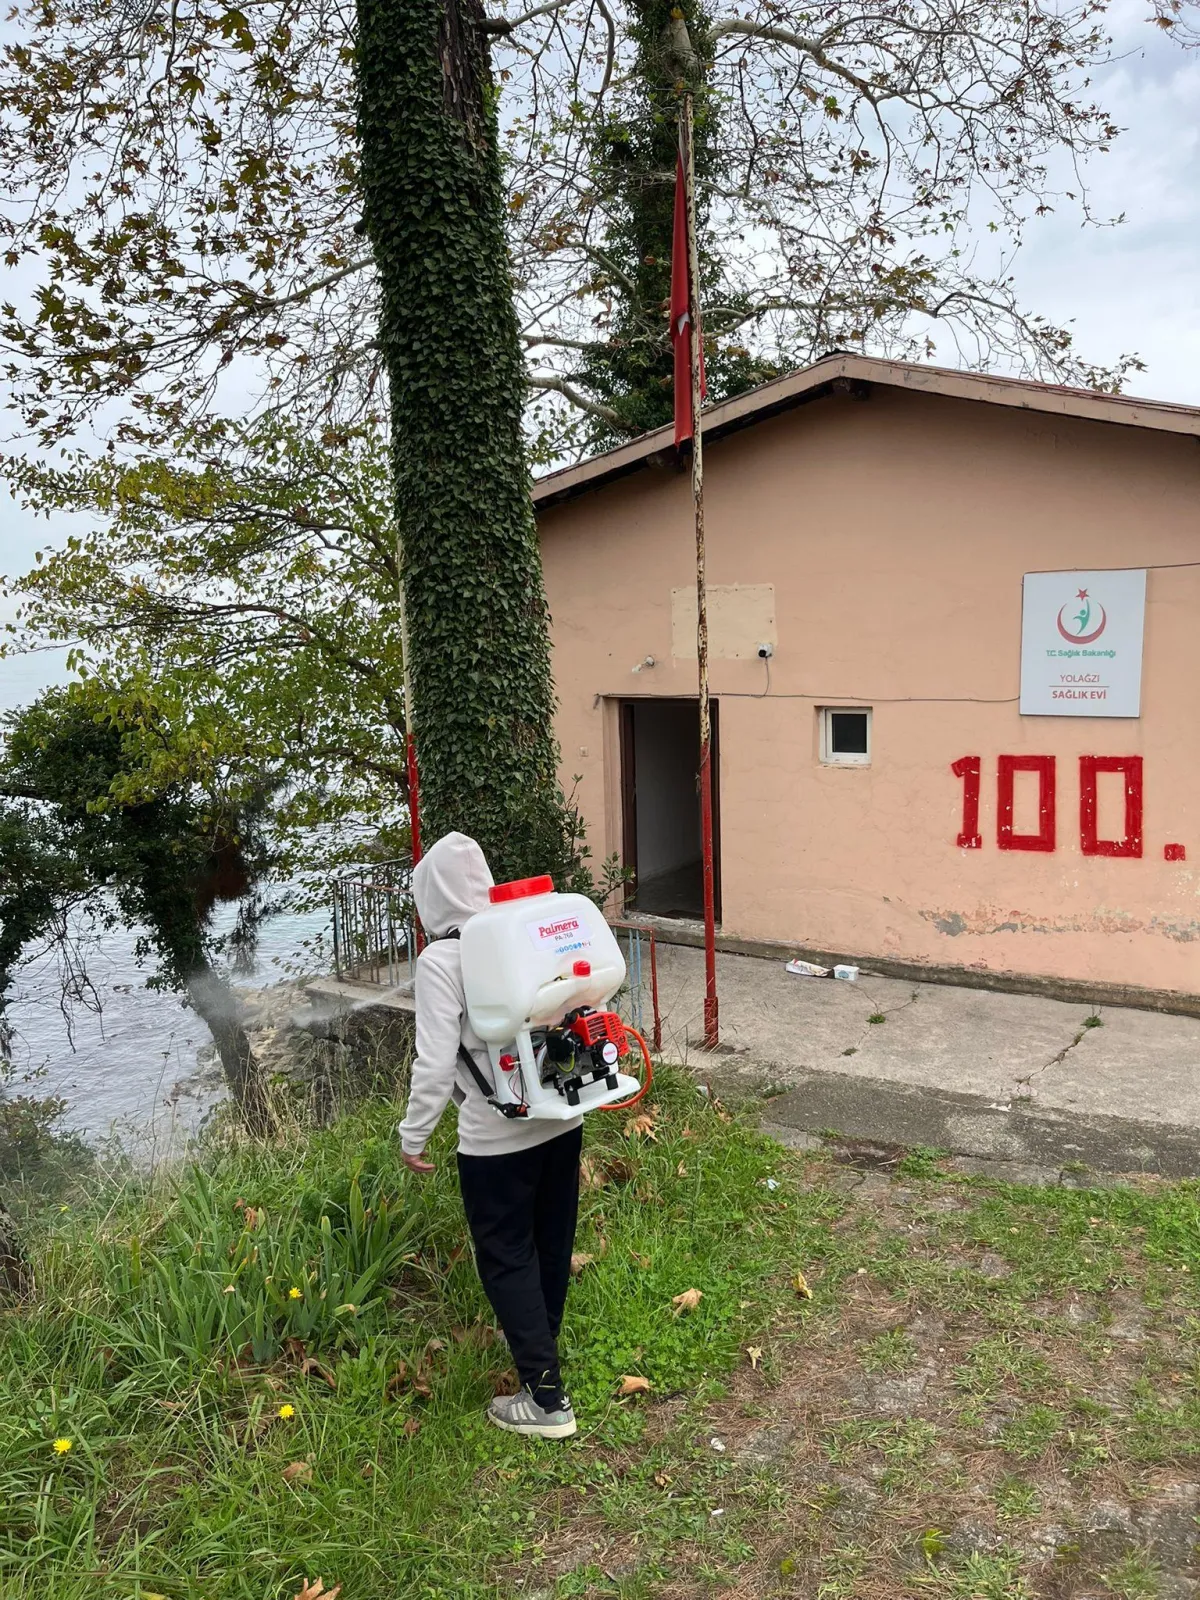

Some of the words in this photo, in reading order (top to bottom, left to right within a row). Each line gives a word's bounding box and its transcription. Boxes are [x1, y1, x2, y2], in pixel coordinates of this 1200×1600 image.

[1058, 649, 1080, 658] Sağlık
[1082, 649, 1116, 658] Bakanlığı
[1060, 673, 1100, 683] YOLAĞZI
[1052, 689, 1088, 699] SAĞLIK
[1090, 689, 1106, 699] EVİ
[538, 920, 579, 937] Palmera
